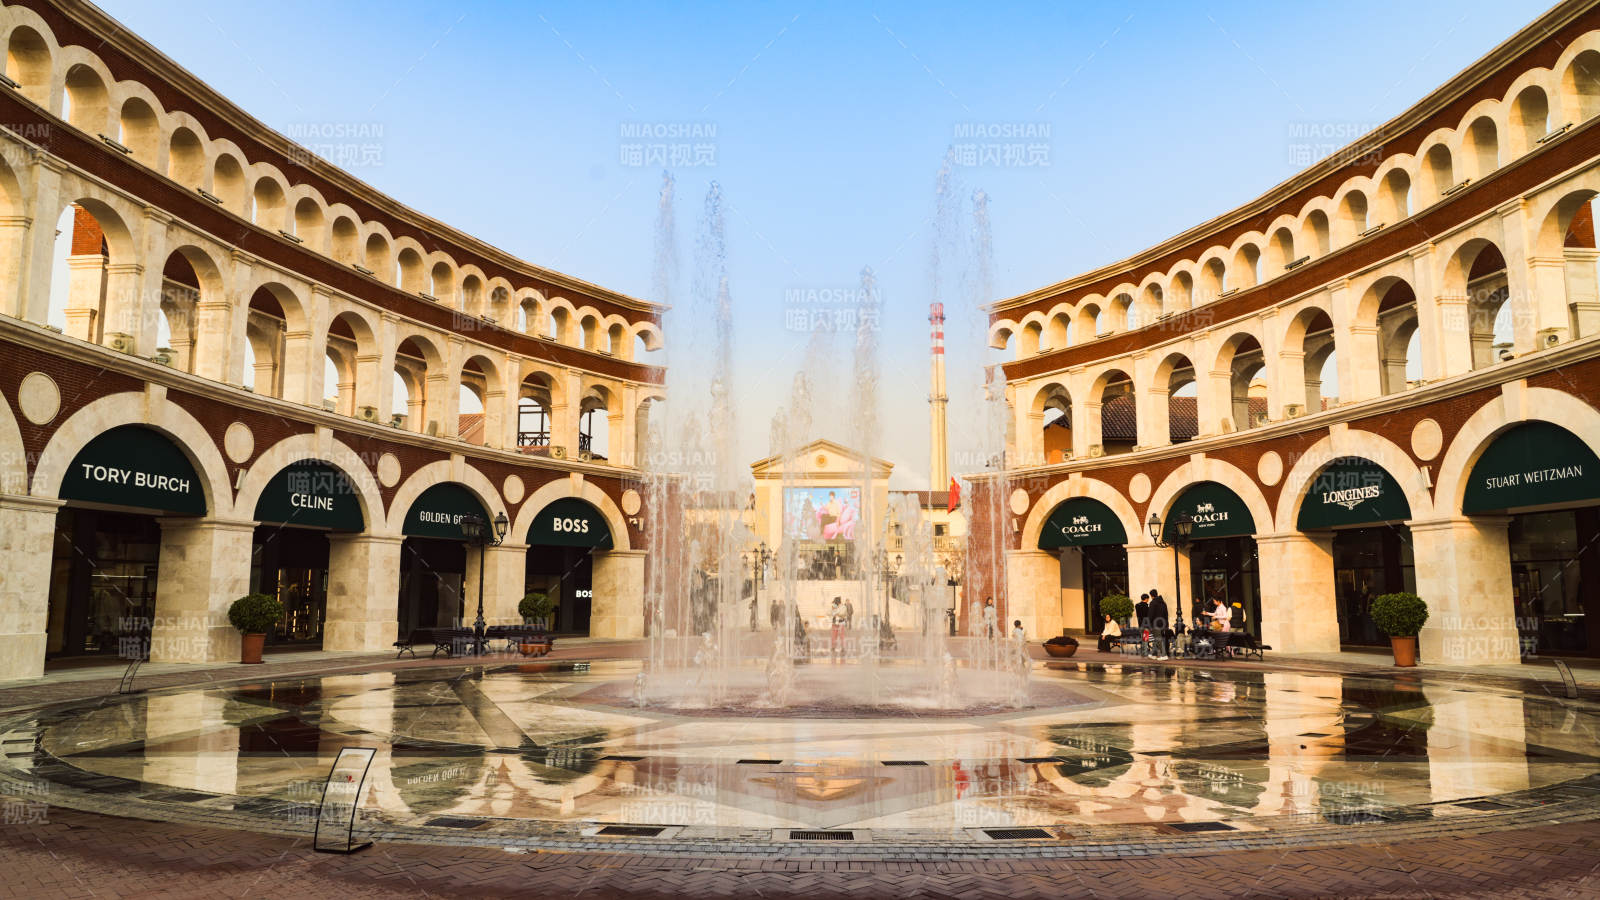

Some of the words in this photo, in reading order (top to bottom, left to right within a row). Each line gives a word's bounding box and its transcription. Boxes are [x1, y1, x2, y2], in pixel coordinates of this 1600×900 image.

[81, 463, 132, 485] TORY
[134, 472, 190, 494] BURCH
[1486, 473, 1520, 490] STUART
[1523, 465, 1583, 484] WEITZMAN
[291, 493, 334, 511] CELINE
[1322, 485, 1380, 504] LONGINES
[420, 510, 451, 524] GOLDEN
[553, 517, 589, 534] BOSS
[1191, 511, 1229, 523] OACH
[1061, 523, 1102, 534] COACH
[575, 589, 592, 598] BOS
